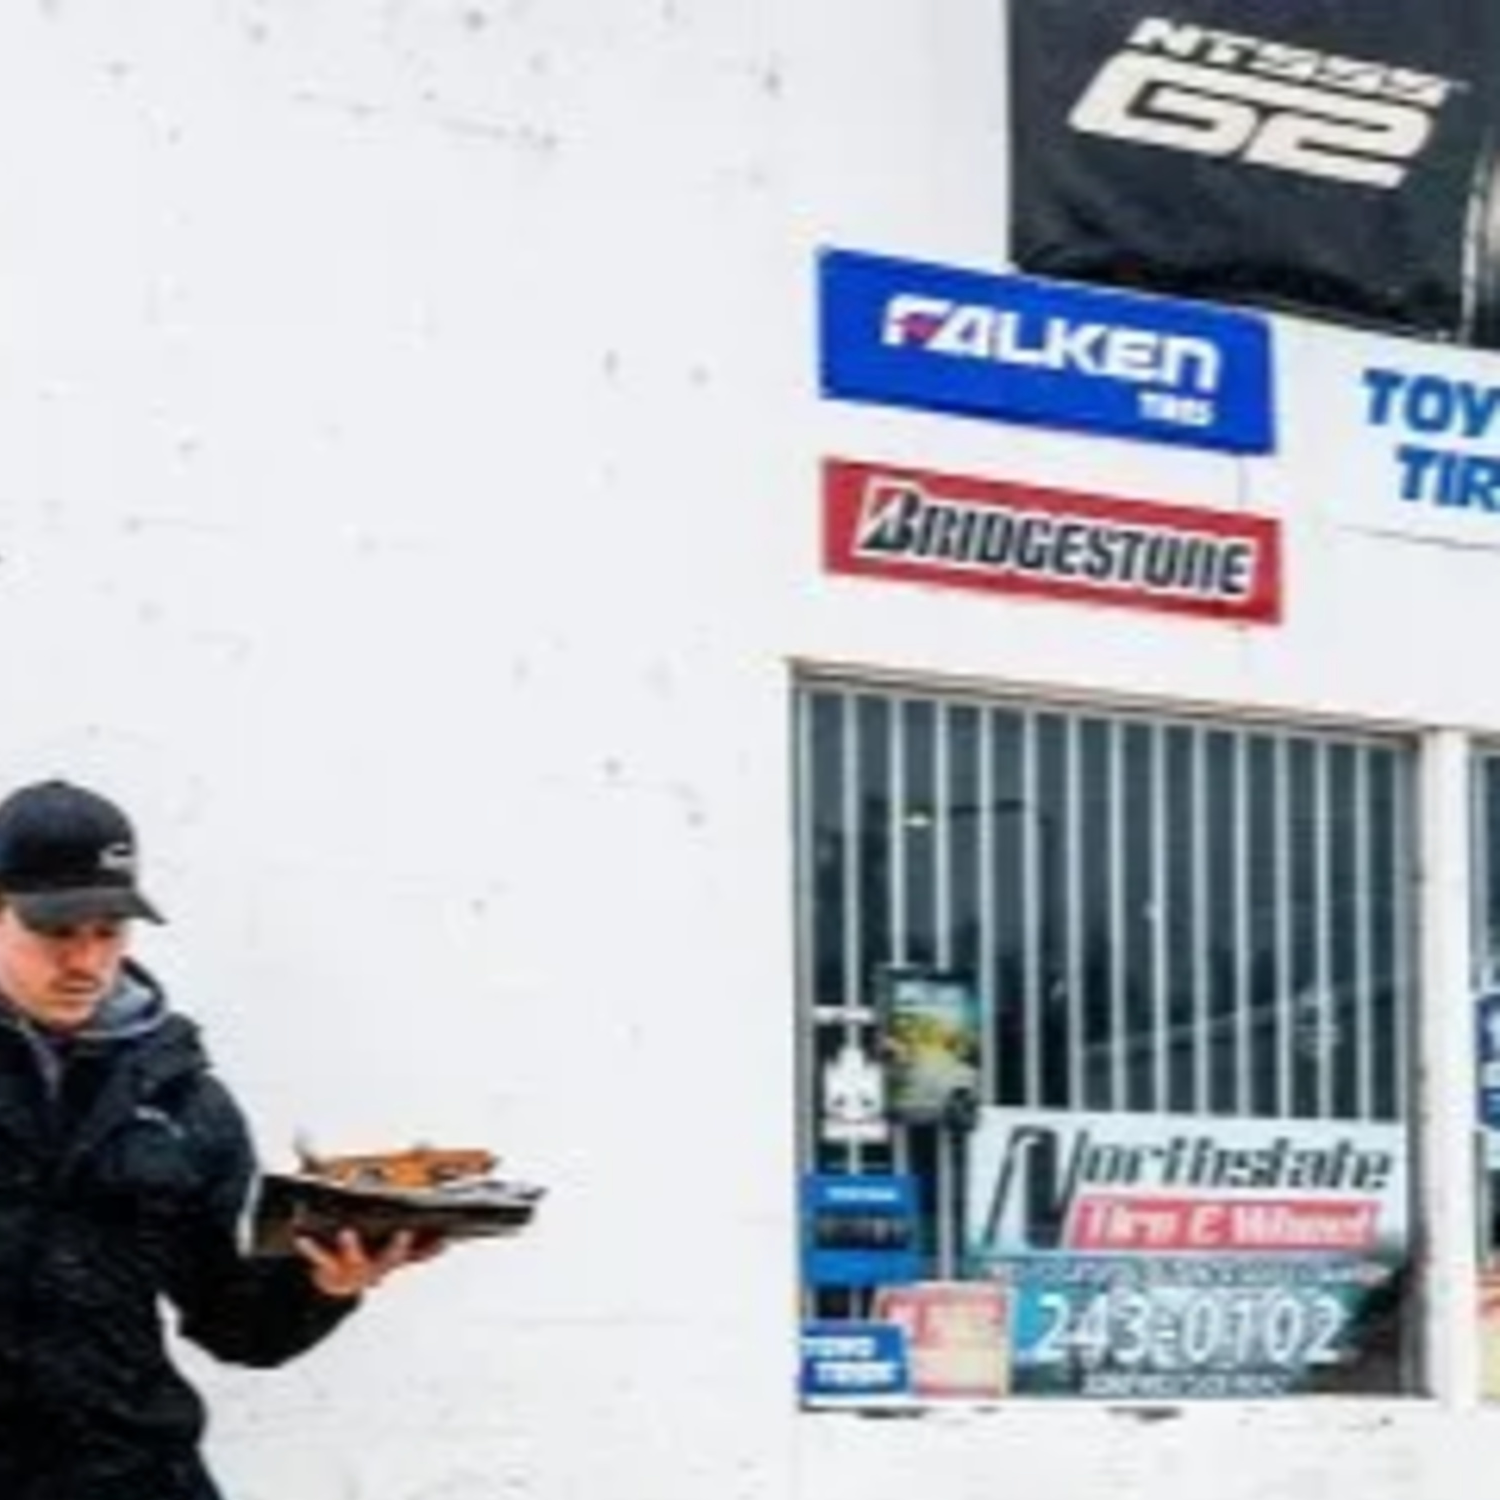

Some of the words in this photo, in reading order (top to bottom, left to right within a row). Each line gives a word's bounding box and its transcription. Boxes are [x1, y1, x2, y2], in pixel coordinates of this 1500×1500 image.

[1067, 49, 1438, 189] G2
[881, 293, 1220, 392] FALKEN
[860, 486, 1251, 597] BRIDGESTONE
[982, 1124, 1393, 1252] Northstate
[1033, 1292, 1346, 1363] 243-0102
